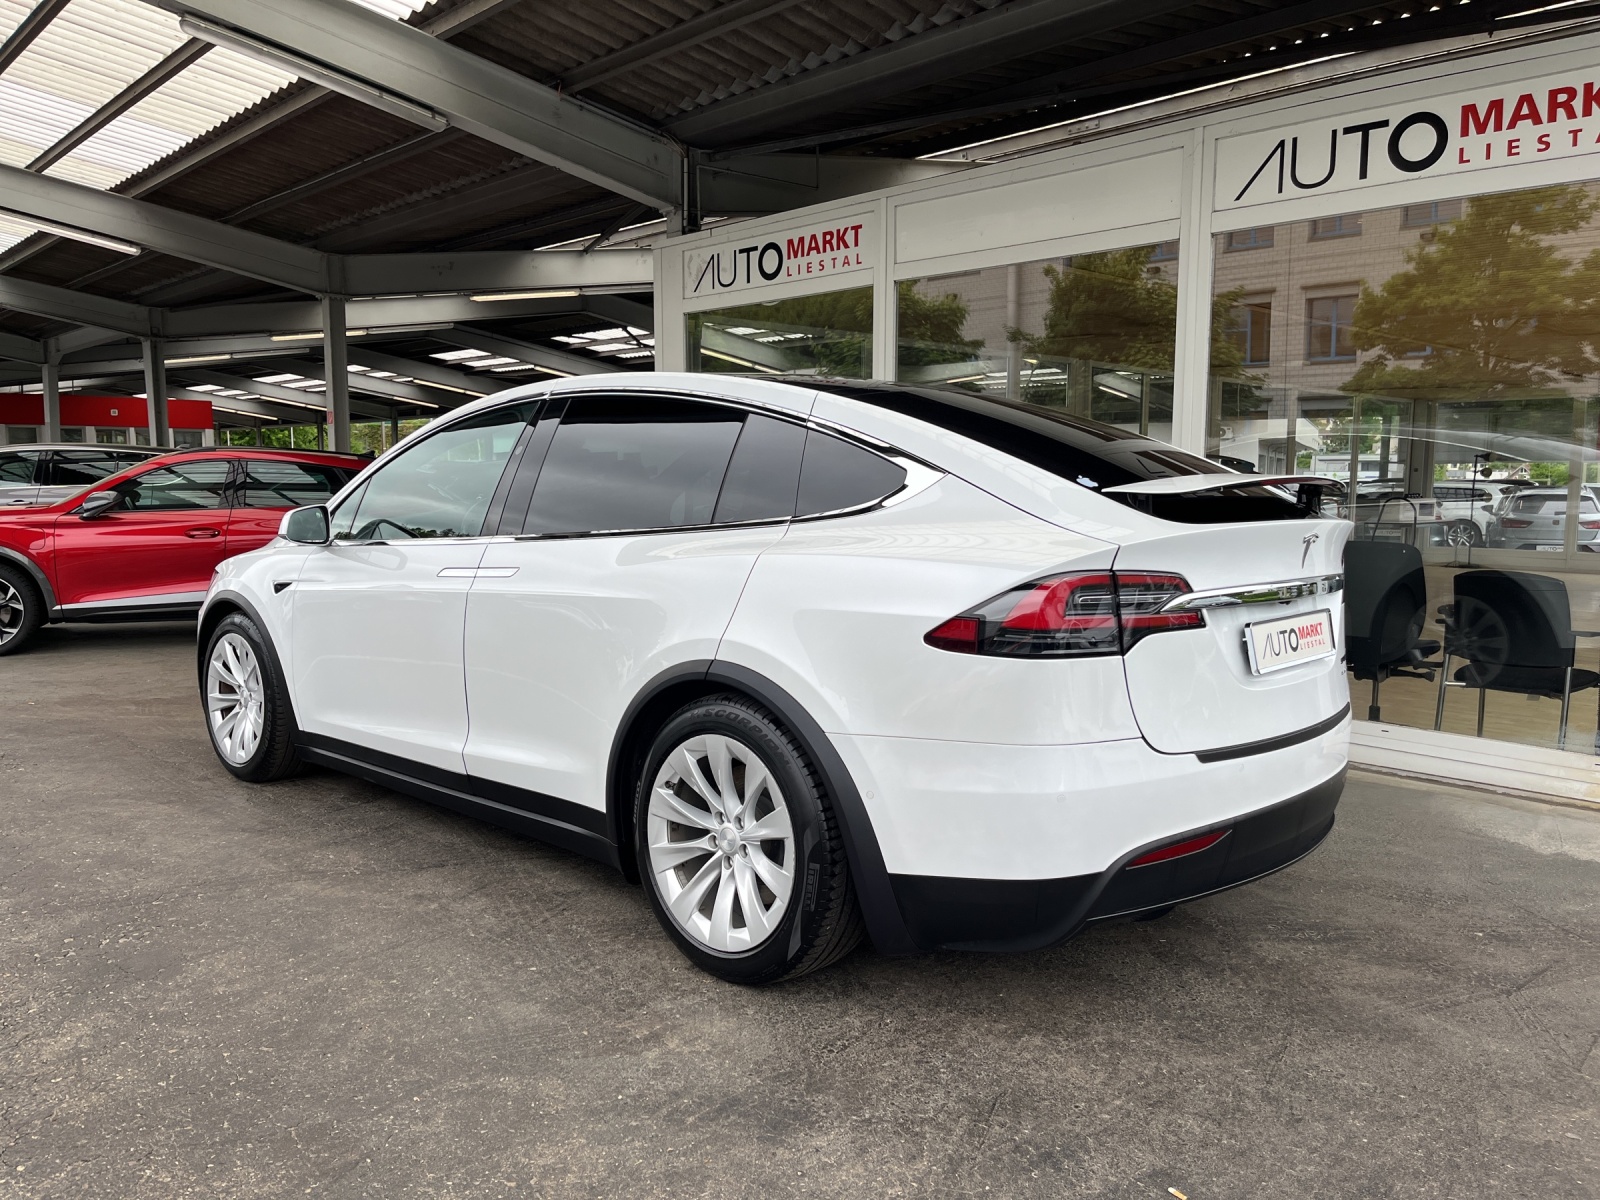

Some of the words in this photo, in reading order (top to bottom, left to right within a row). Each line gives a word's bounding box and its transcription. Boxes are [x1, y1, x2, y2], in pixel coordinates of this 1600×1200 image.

[1234, 111, 1449, 202] AUTO
[693, 242, 784, 293] AUTO
[786, 224, 863, 260] MARKT
[786, 253, 863, 278] LIESTAL
[1262, 627, 1299, 660] AUTO
[1297, 622, 1323, 641] MARKT
[1299, 638, 1326, 651] LIESTAL
[702, 708, 791, 769] SCORPION
